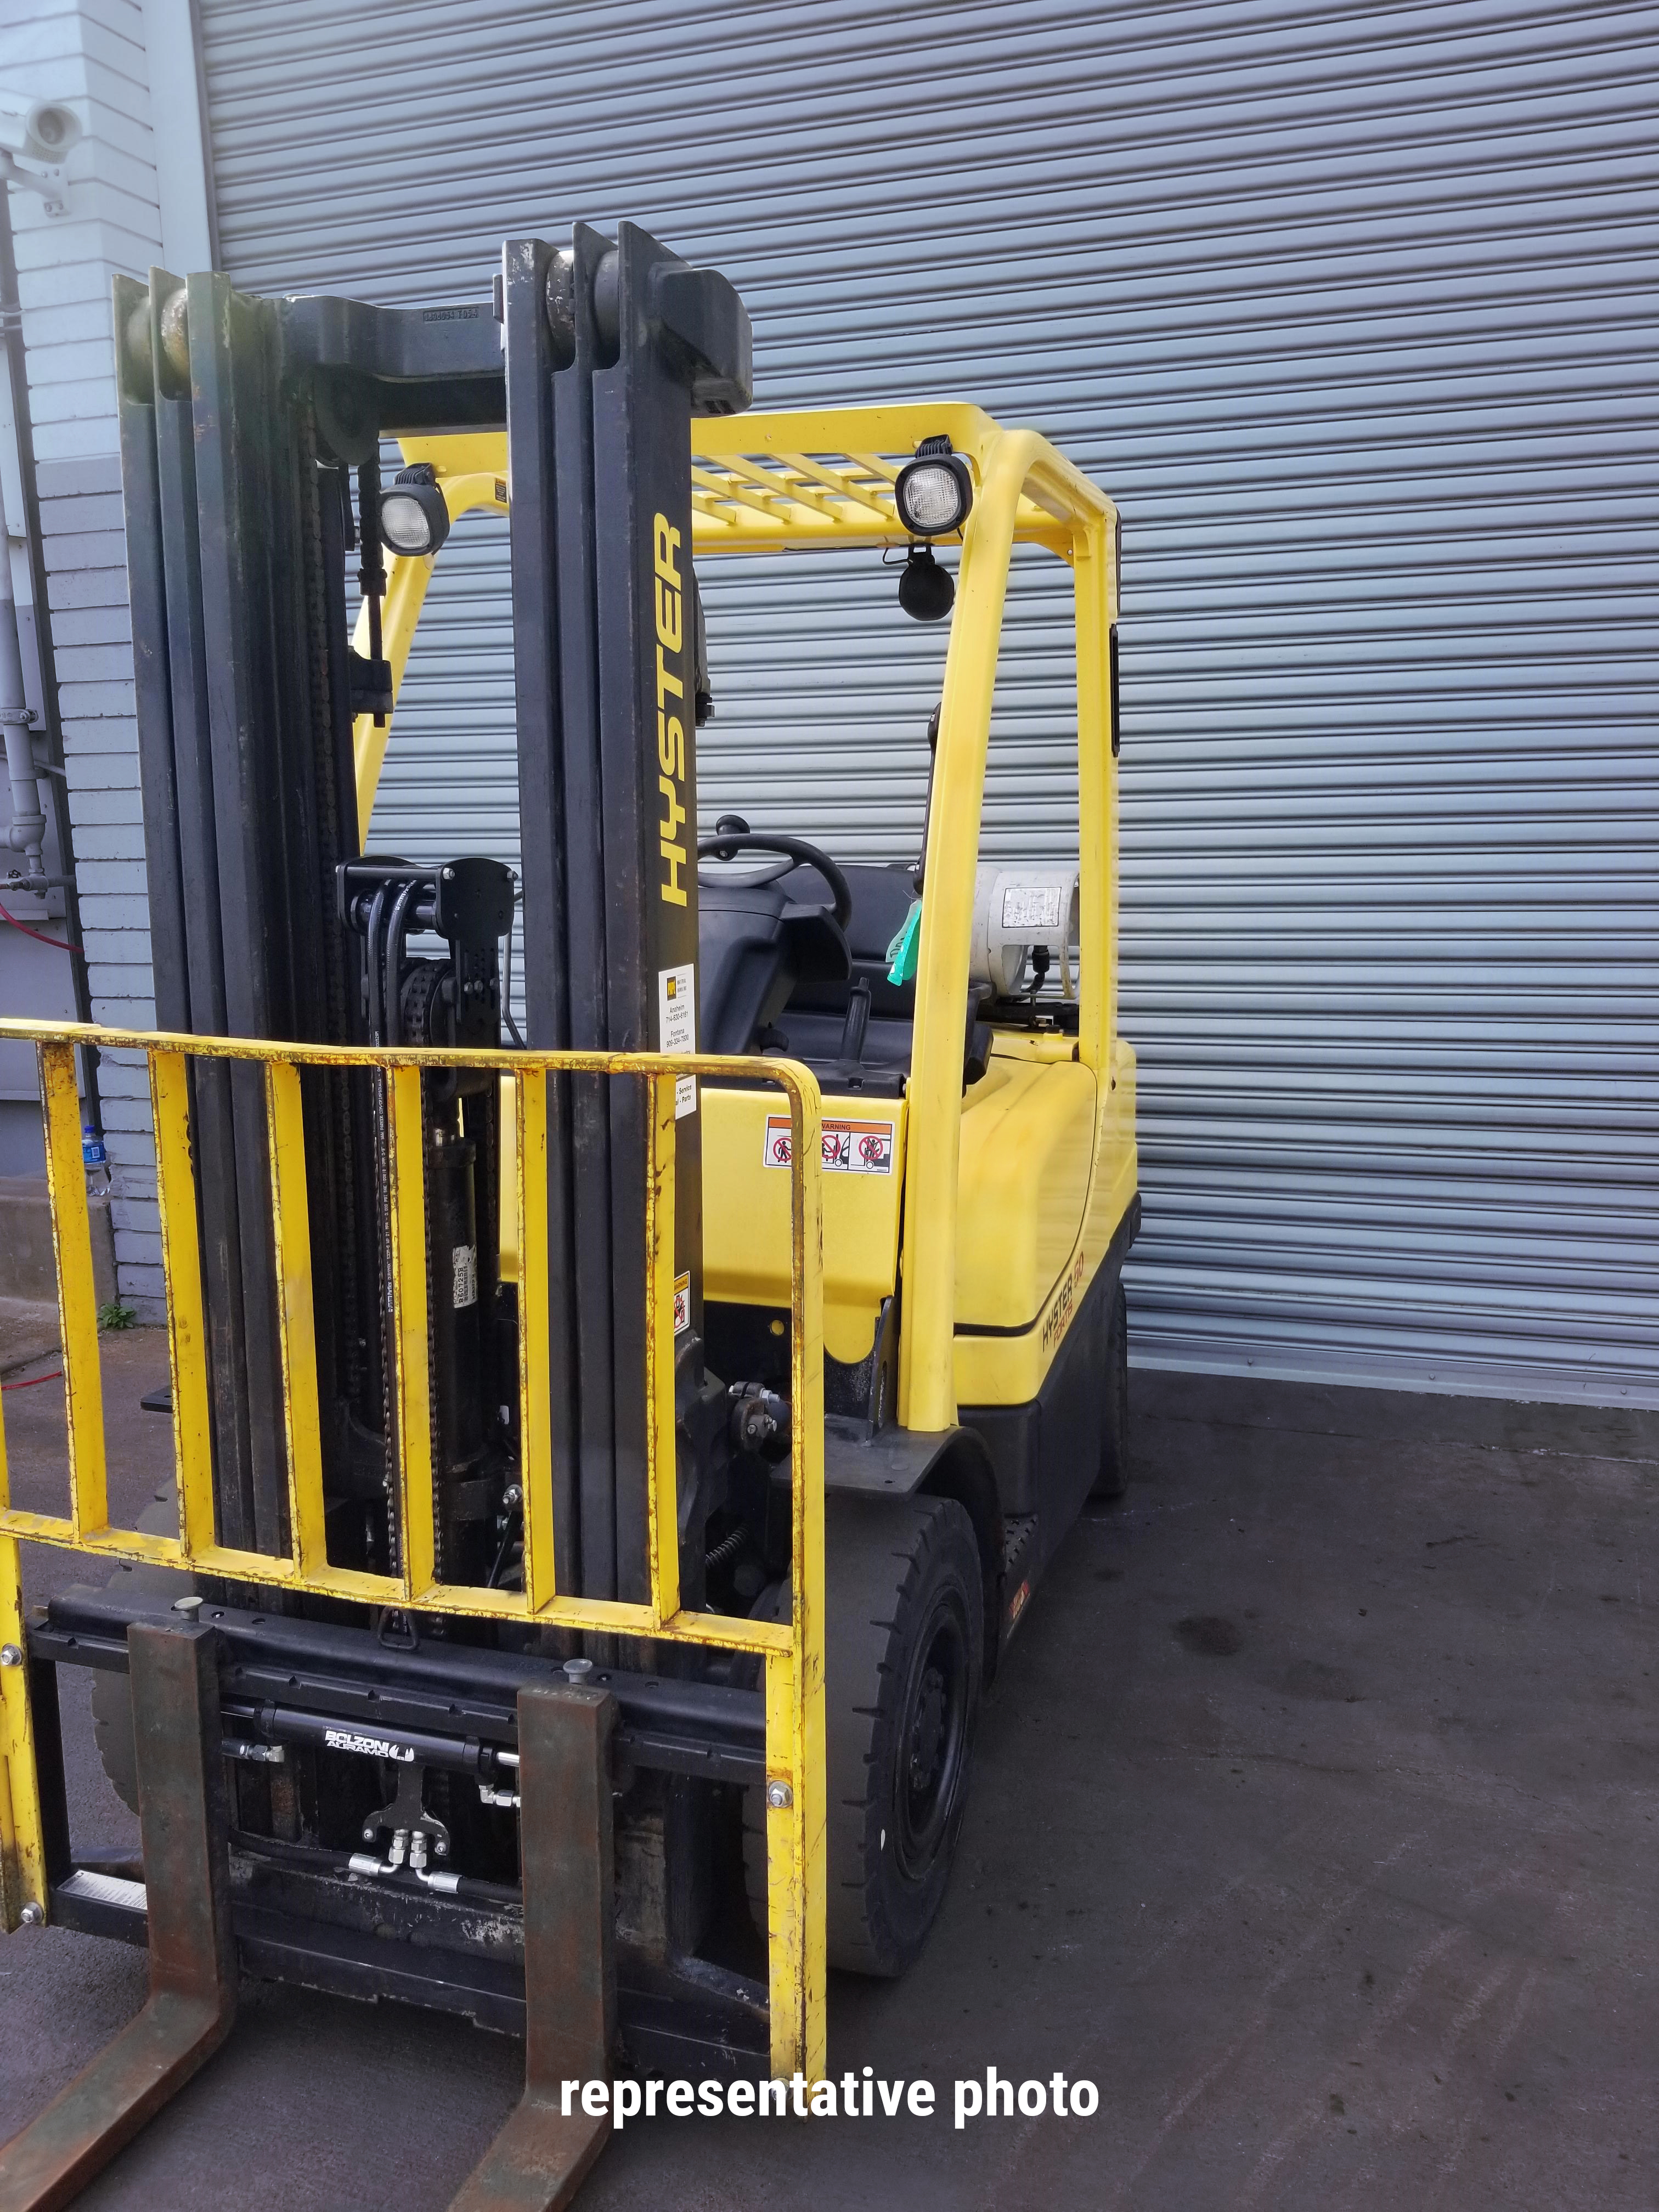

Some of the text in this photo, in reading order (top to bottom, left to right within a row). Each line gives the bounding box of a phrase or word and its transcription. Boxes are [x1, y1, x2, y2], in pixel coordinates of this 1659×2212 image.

[654, 513, 687, 907] HYSTER
[670, 1005, 685, 1013] Anaheim
[670, 1029, 685, 1037] Fontana
[679, 1085, 692, 1094] Service
[1043, 1273, 1073, 1353] HYSTER
[325, 1730, 390, 1752] BOLZONI
[326, 1740, 390, 1758] AURAMO
